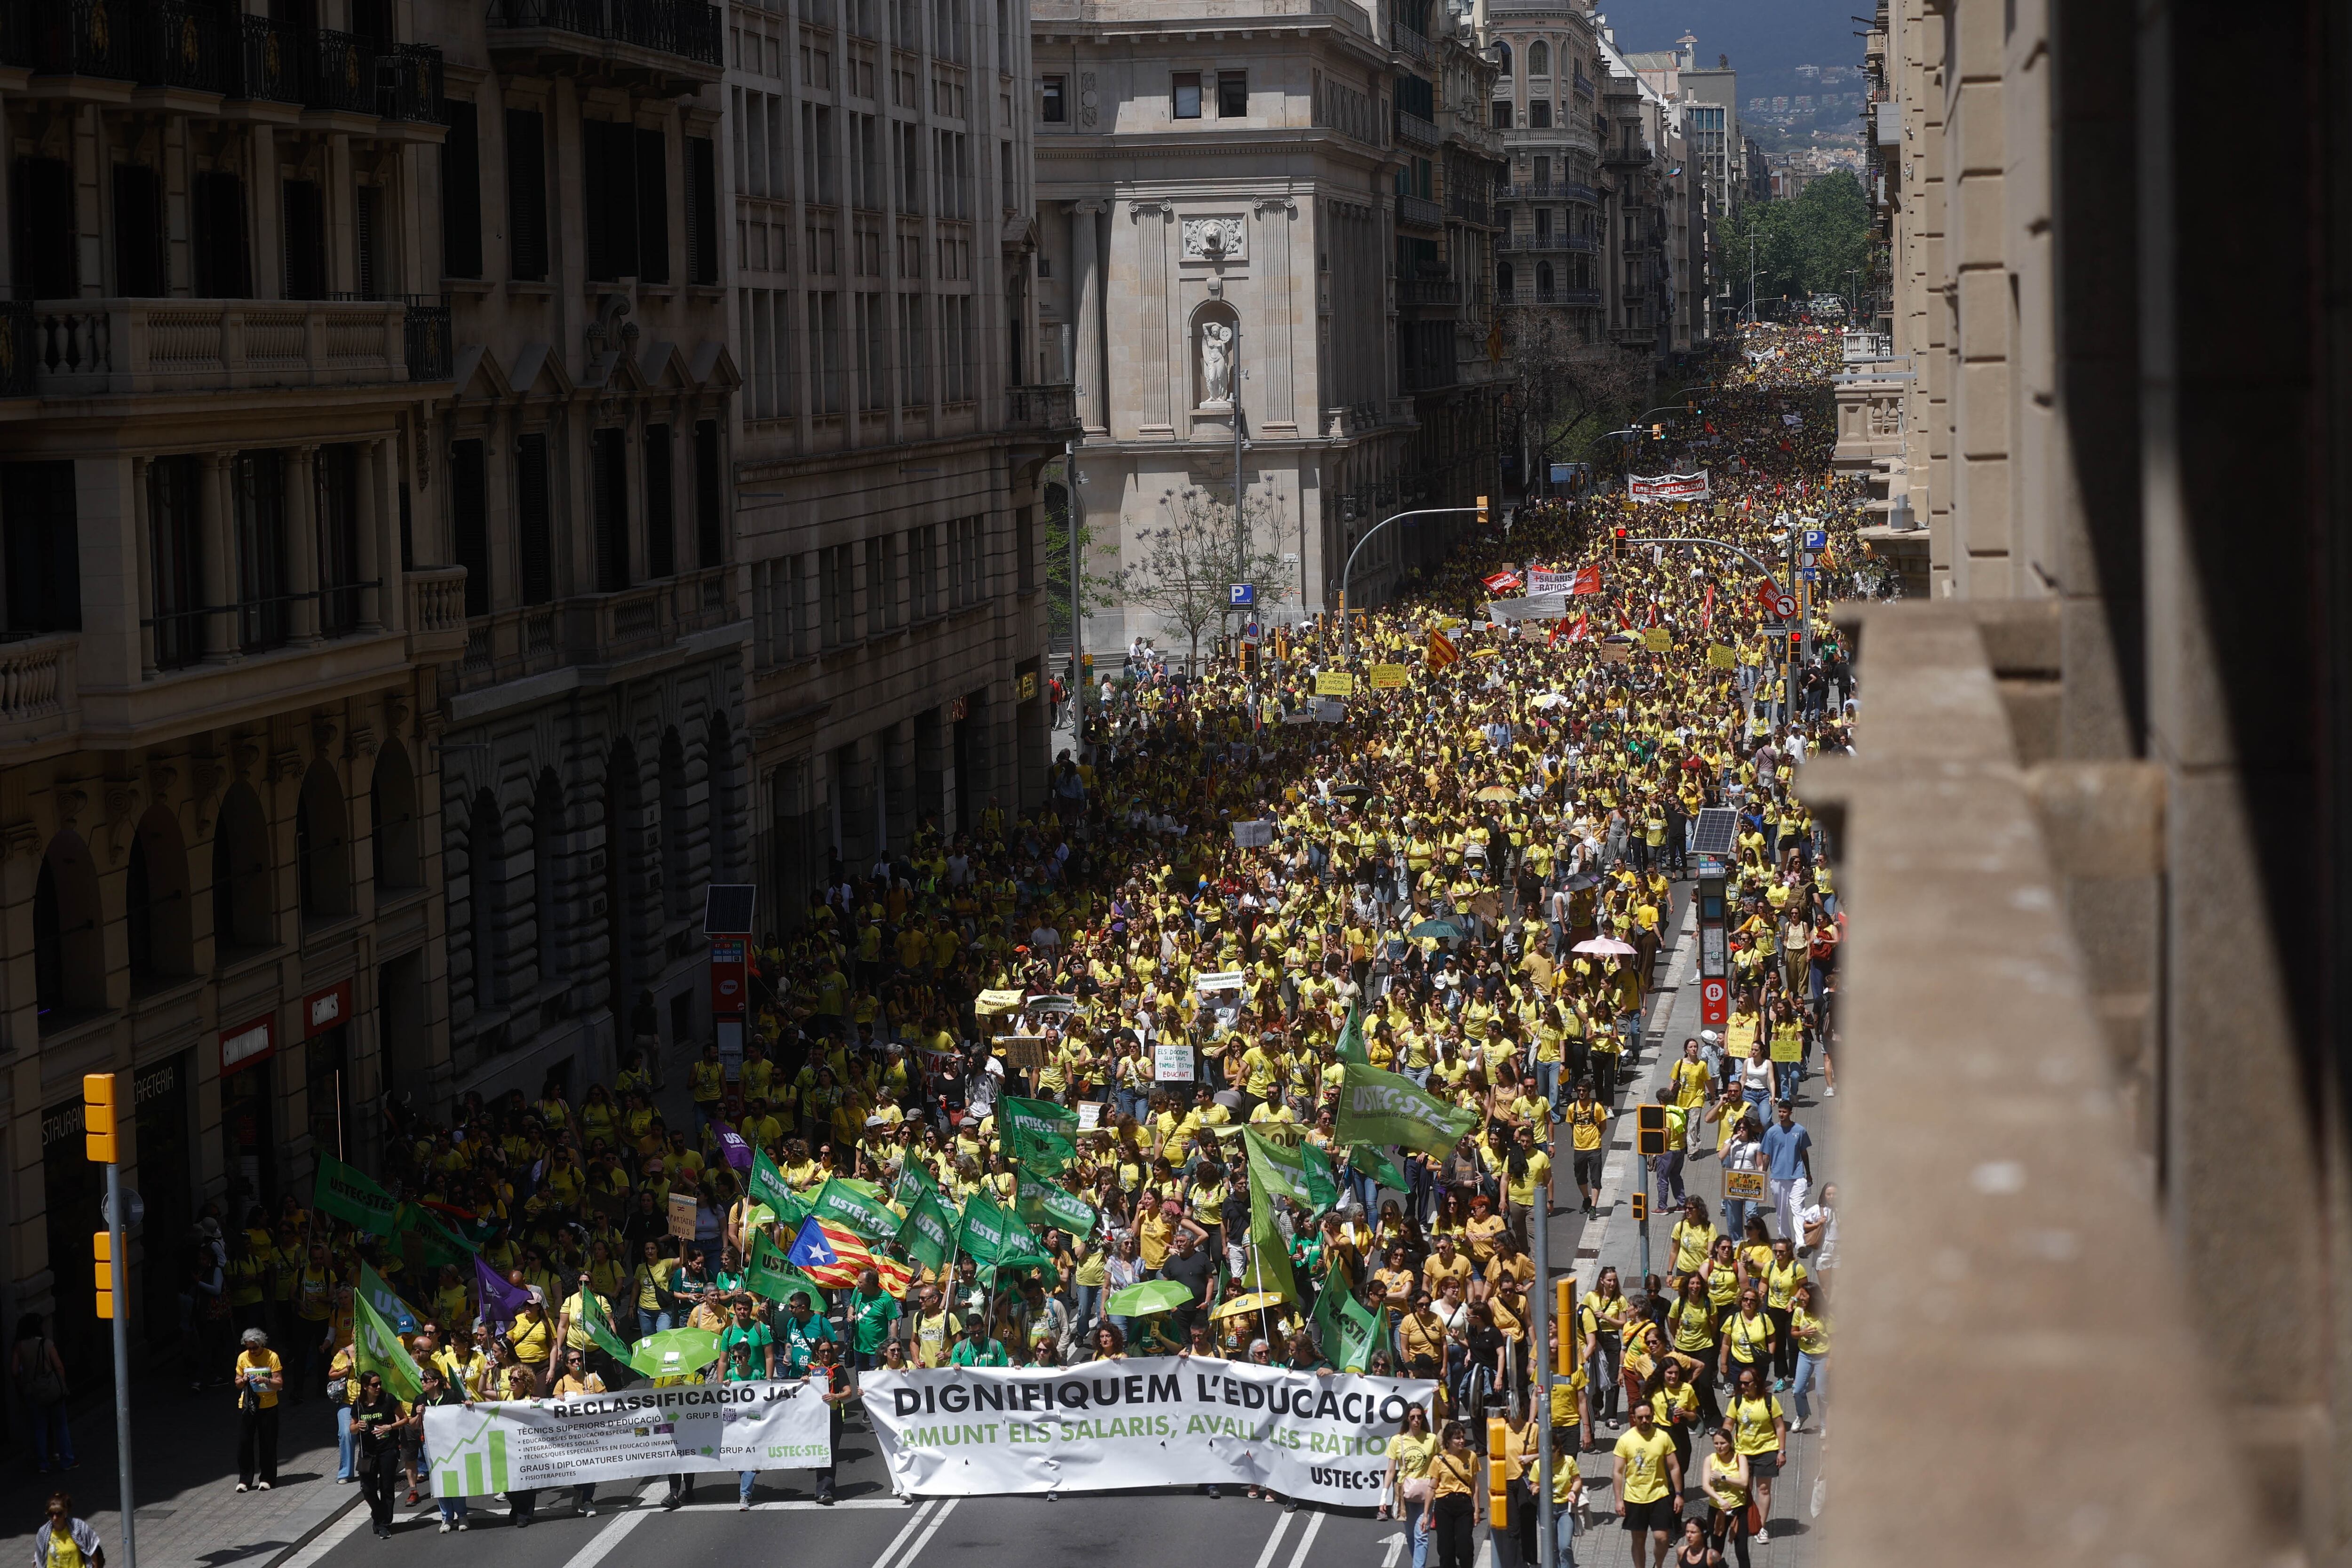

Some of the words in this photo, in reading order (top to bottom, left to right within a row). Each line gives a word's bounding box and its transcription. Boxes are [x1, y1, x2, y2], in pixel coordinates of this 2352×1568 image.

[1659, 480, 1704, 493] EDUCACIÓ
[1807, 532, 1818, 546] P
[1232, 586, 1244, 602] P
[1711, 650, 1734, 663] NECESSITA
[41, 1105, 84, 1146] STAURAN
[1400, 1113, 1431, 1128] Catalunya
[331, 1177, 395, 1211] USTEC·STEs
[670, 1214, 695, 1226] PORTÀTILS
[672, 1225, 690, 1235] NOUS
[915, 1211, 949, 1250] USTEC
[970, 1218, 1001, 1245] USTE
[554, 1384, 755, 1419] RECLASSIFICACIÓ
[763, 1386, 798, 1402] JA!
[894, 1374, 1181, 1417] DIGNIFIQUEM
[1197, 1374, 1408, 1424] L'EDUCACIÓ
[517, 1426, 554, 1436] TÈCNICS
[556, 1420, 605, 1433] SUPERIORS
[608, 1415, 661, 1427] D'EDUCACIÓ
[523, 1435, 567, 1445] EDUCADORS/ES
[569, 1431, 604, 1440] D'EDUCACIÓ
[903, 1424, 999, 1447] AMUNT
[1009, 1423, 1050, 1443] ELS
[1060, 1415, 1177, 1441] SALARIS,
[1186, 1414, 1262, 1441] AVALL
[1270, 1425, 1300, 1450] LES
[1310, 1427, 1388, 1456] RÀTIO
[523, 1442, 573, 1452] INTEGRADORS/ES
[524, 1451, 565, 1460] TÈCNICS/QUES
[567, 1446, 609, 1456] ESPECIALISTES
[768, 1444, 829, 1458] USTEC·STEs
[520, 1463, 550, 1473] GRAUS
[557, 1455, 623, 1470] DIPLOMATURES
[626, 1449, 696, 1462] UNIVERSITÀRIES
[525, 1471, 576, 1481] FISIOTERAPEUTES
[1311, 1466, 1398, 1489] USTEC·ST
